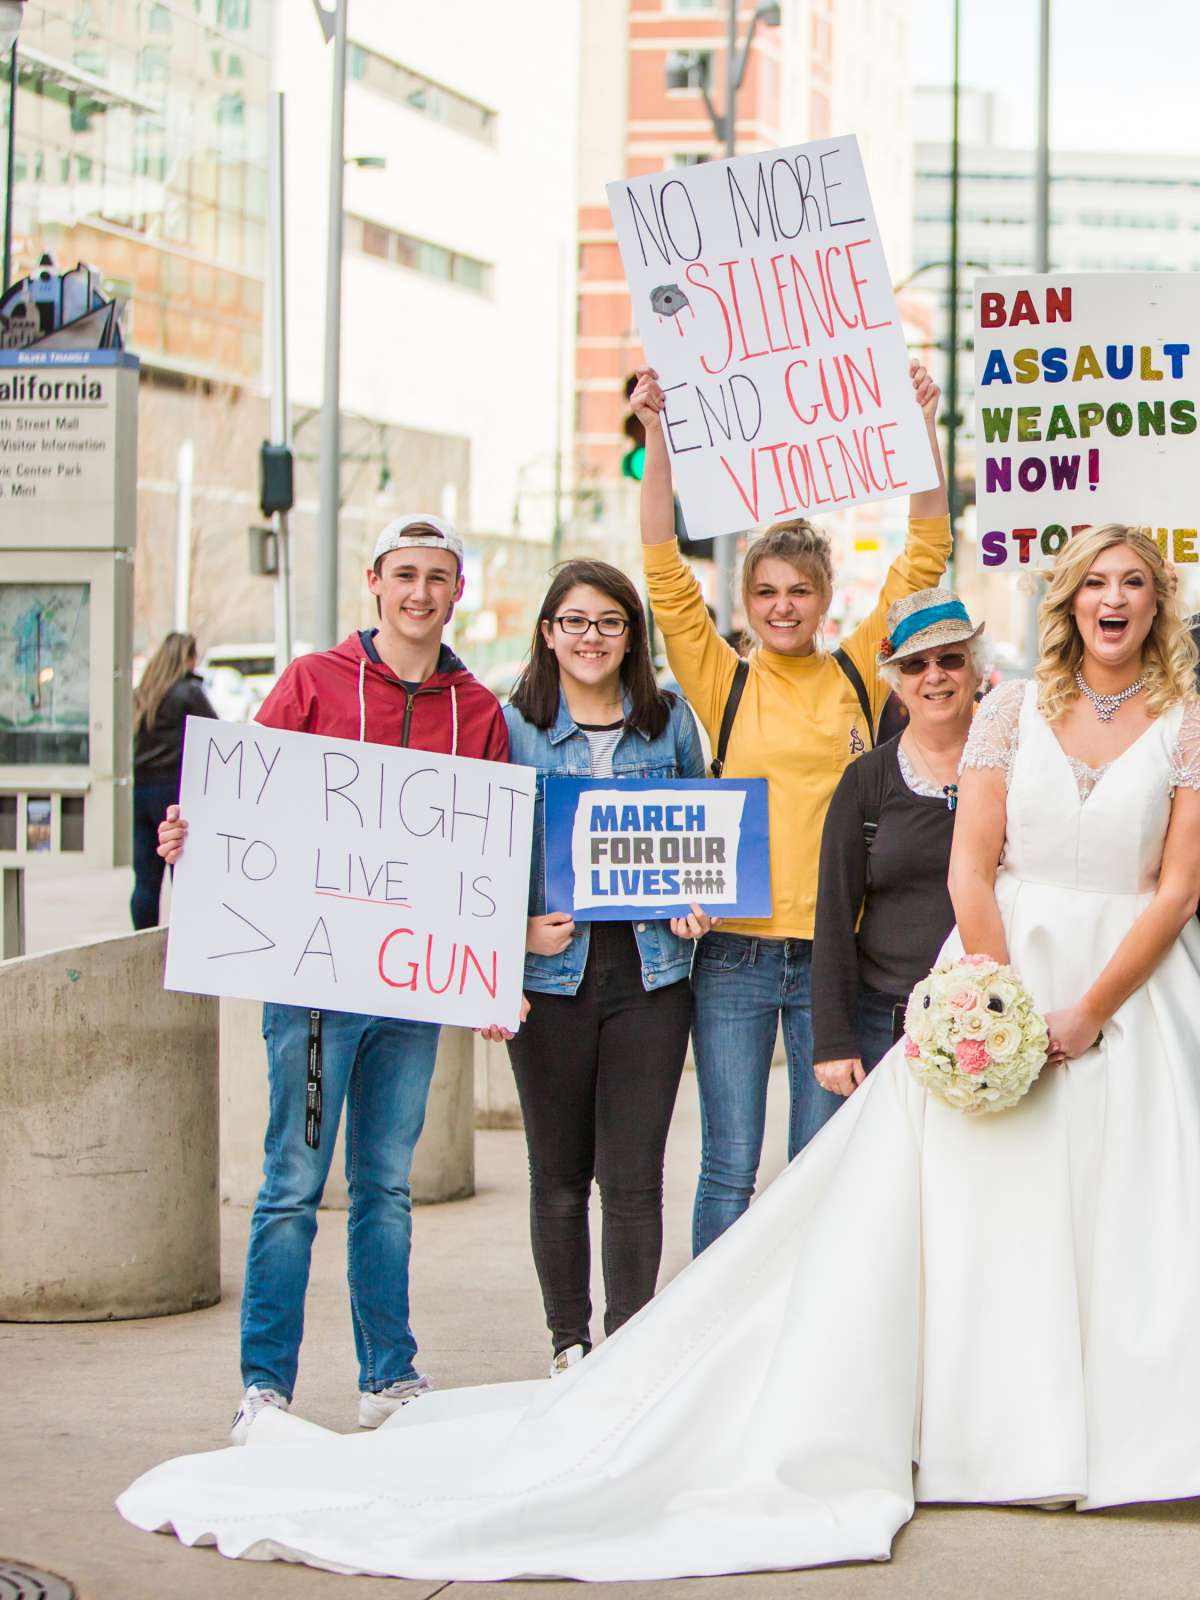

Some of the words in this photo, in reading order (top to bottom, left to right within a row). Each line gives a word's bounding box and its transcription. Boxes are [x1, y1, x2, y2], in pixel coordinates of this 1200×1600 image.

[627, 180, 702, 266] NO
[726, 149, 866, 248] MORE
[685, 239, 892, 374] SILENCE
[980, 287, 1072, 328] BAN
[981, 344, 1190, 385] ASSAULT
[662, 374, 762, 454] END
[784, 347, 882, 425] GUN
[981, 400, 1197, 443] WEAPONS
[16, 418, 50, 431] Street
[56, 417, 80, 430] Mall
[41, 439, 106, 452] Information
[11, 484, 36, 497] Mint
[16, 463, 52, 477] Center
[57, 463, 82, 477] Park
[720, 422, 908, 522] VIOLENCE
[986, 448, 1100, 493] NOW!
[204, 737, 281, 804] MY
[323, 752, 529, 857] RIGHT
[590, 805, 705, 832] MARCH
[591, 837, 653, 864] FOR
[659, 837, 726, 864] OUR
[216, 833, 277, 881] TO
[315, 848, 409, 901] LIVE
[459, 871, 496, 918] IS
[591, 869, 681, 896] LIVES
[294, 916, 337, 982] A
[378, 928, 497, 999] GUN
